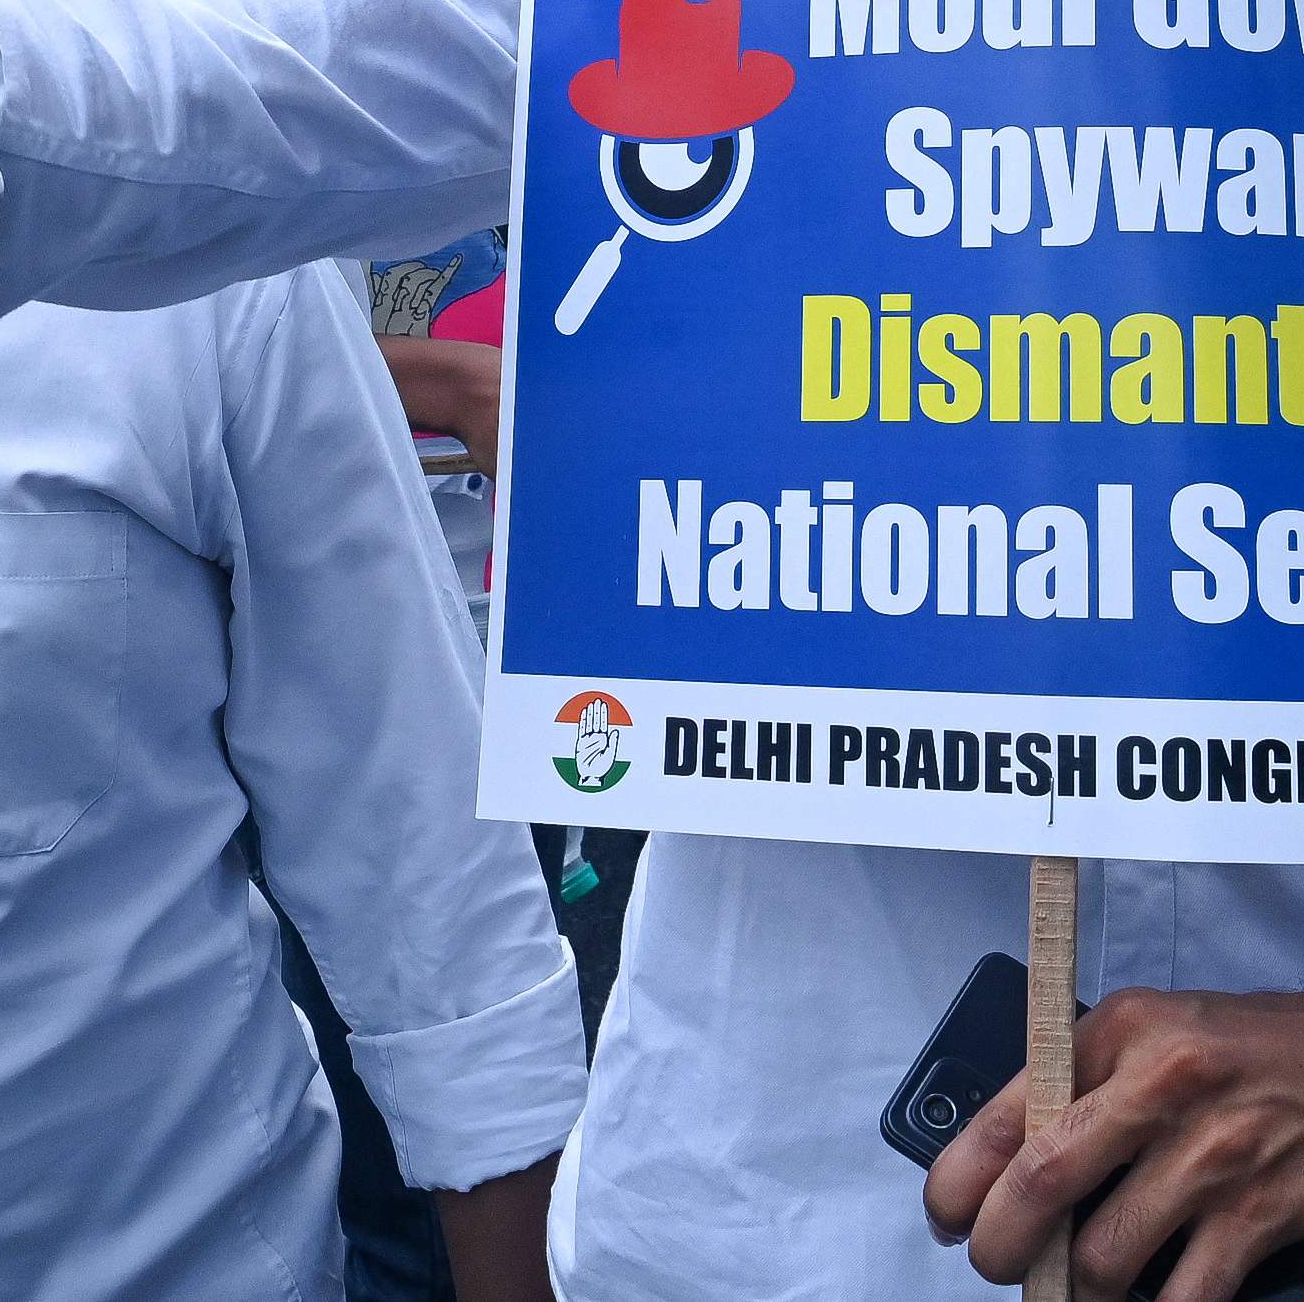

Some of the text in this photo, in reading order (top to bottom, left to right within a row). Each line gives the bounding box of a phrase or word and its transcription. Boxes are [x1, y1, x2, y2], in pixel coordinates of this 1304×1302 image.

[635, 478, 1137, 624] National
[662, 714, 814, 789] DELHI
[826, 722, 1100, 801] PRADESH
